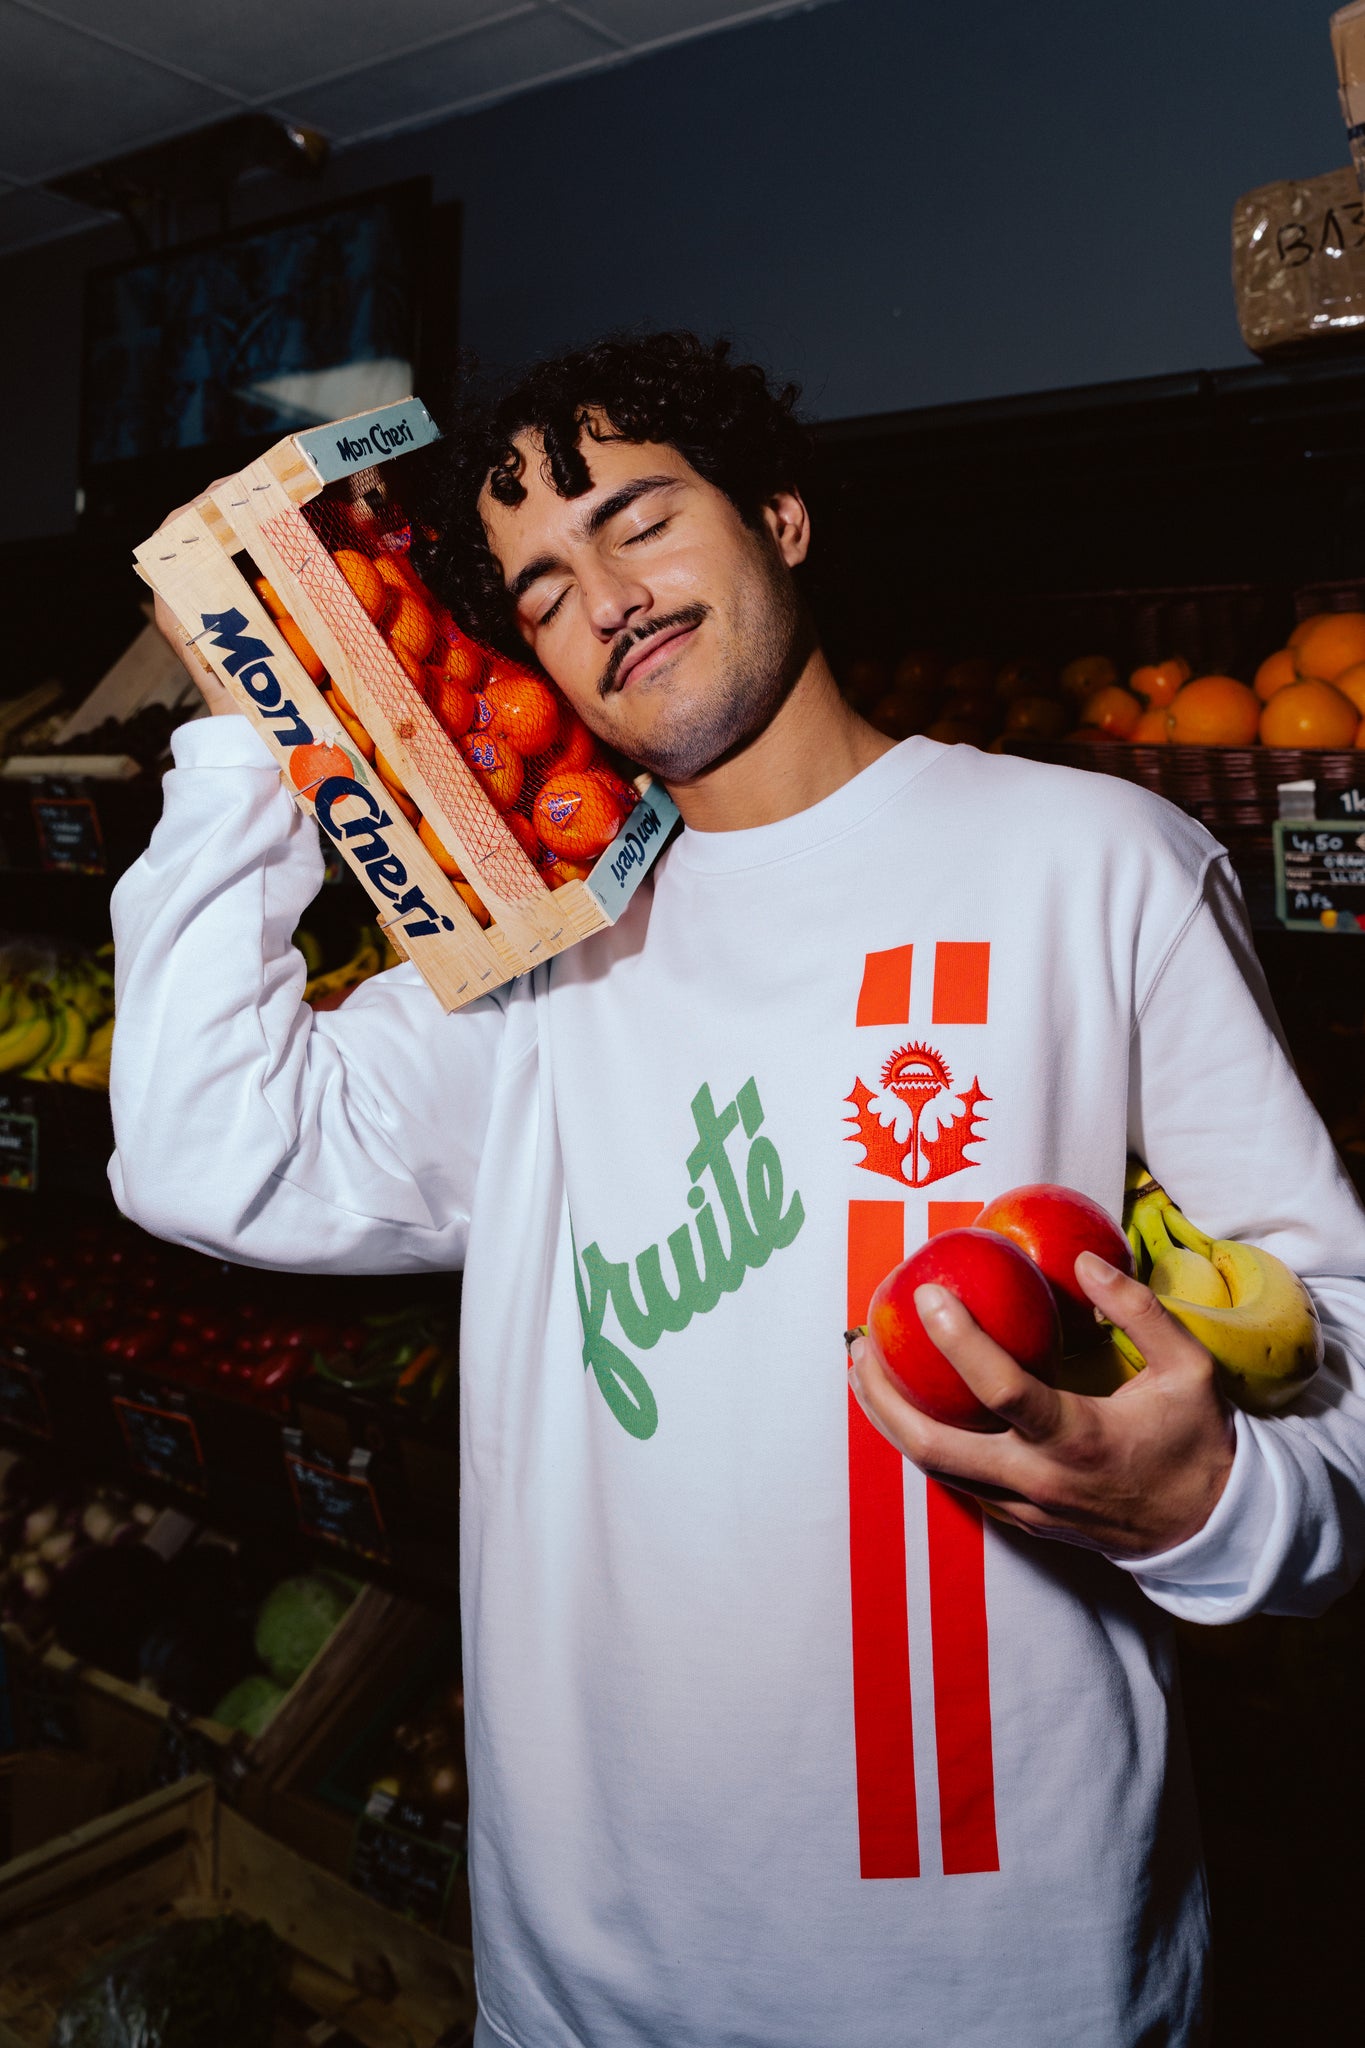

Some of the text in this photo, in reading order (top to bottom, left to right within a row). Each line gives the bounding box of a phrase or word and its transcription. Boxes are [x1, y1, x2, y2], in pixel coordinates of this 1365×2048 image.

[335, 418, 415, 462] Mon Cheri
[201, 606, 455, 938] Mon Cheri
[636, 808, 662, 844] Mon
[610, 832, 646, 889] Cheri
